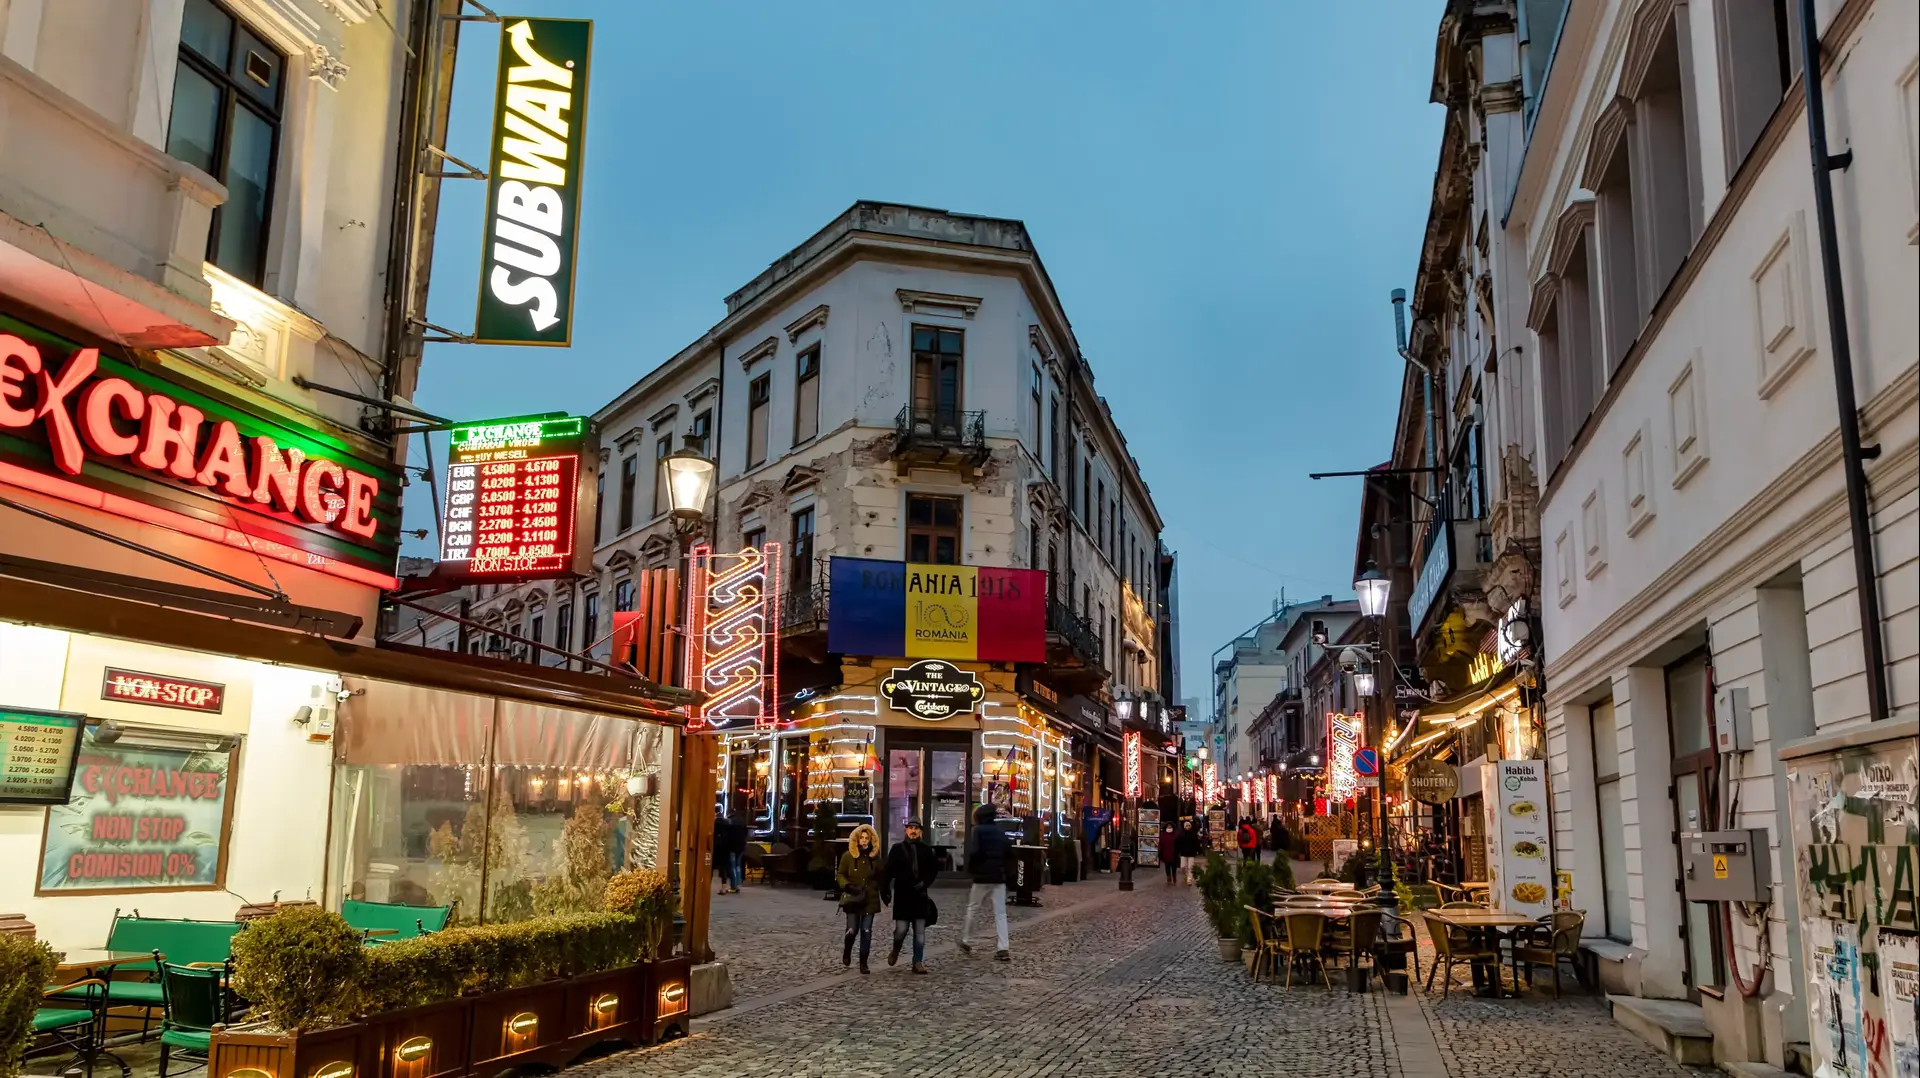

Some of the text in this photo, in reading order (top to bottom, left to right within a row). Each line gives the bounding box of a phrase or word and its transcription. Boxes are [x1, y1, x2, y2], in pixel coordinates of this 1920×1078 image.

[490, 20, 573, 331] SUBWAY
[468, 423, 543, 441] EXCHANGE
[453, 466, 475, 477] EUR
[481, 463, 516, 476] 4.5800
[524, 460, 560, 473] 4.6700
[453, 480, 475, 491] USD
[481, 477, 516, 489] 4.0200
[524, 474, 560, 486] 4.1300
[451, 493, 475, 505] GBP
[481, 490, 516, 503] 5.0500
[524, 488, 560, 500] 5.2700
[450, 507, 472, 518] CHF
[479, 505, 513, 517] 3.9700
[522, 502, 557, 514] 4.1200
[449, 521, 472, 532] BGN
[479, 519, 513, 531] 2.2700
[522, 516, 557, 528] 2.4500
[447, 534, 471, 546] CAD
[479, 532, 513, 545] 2.9200
[522, 530, 557, 542] 3.1100
[447, 548, 469, 560] TRY
[473, 557, 538, 572] NON STOP
[969, 575, 1021, 599] 1918
[113, 675, 214, 706] NON-STOP
[904, 680, 963, 693] VINTAGE
[915, 700, 949, 714] Carlsberg
[1505, 766, 1534, 775] Habibi
[1411, 777, 1454, 787] SHOTERIA
[93, 816, 184, 841] NON STOP
[69, 853, 195, 878] COMISION 0%
